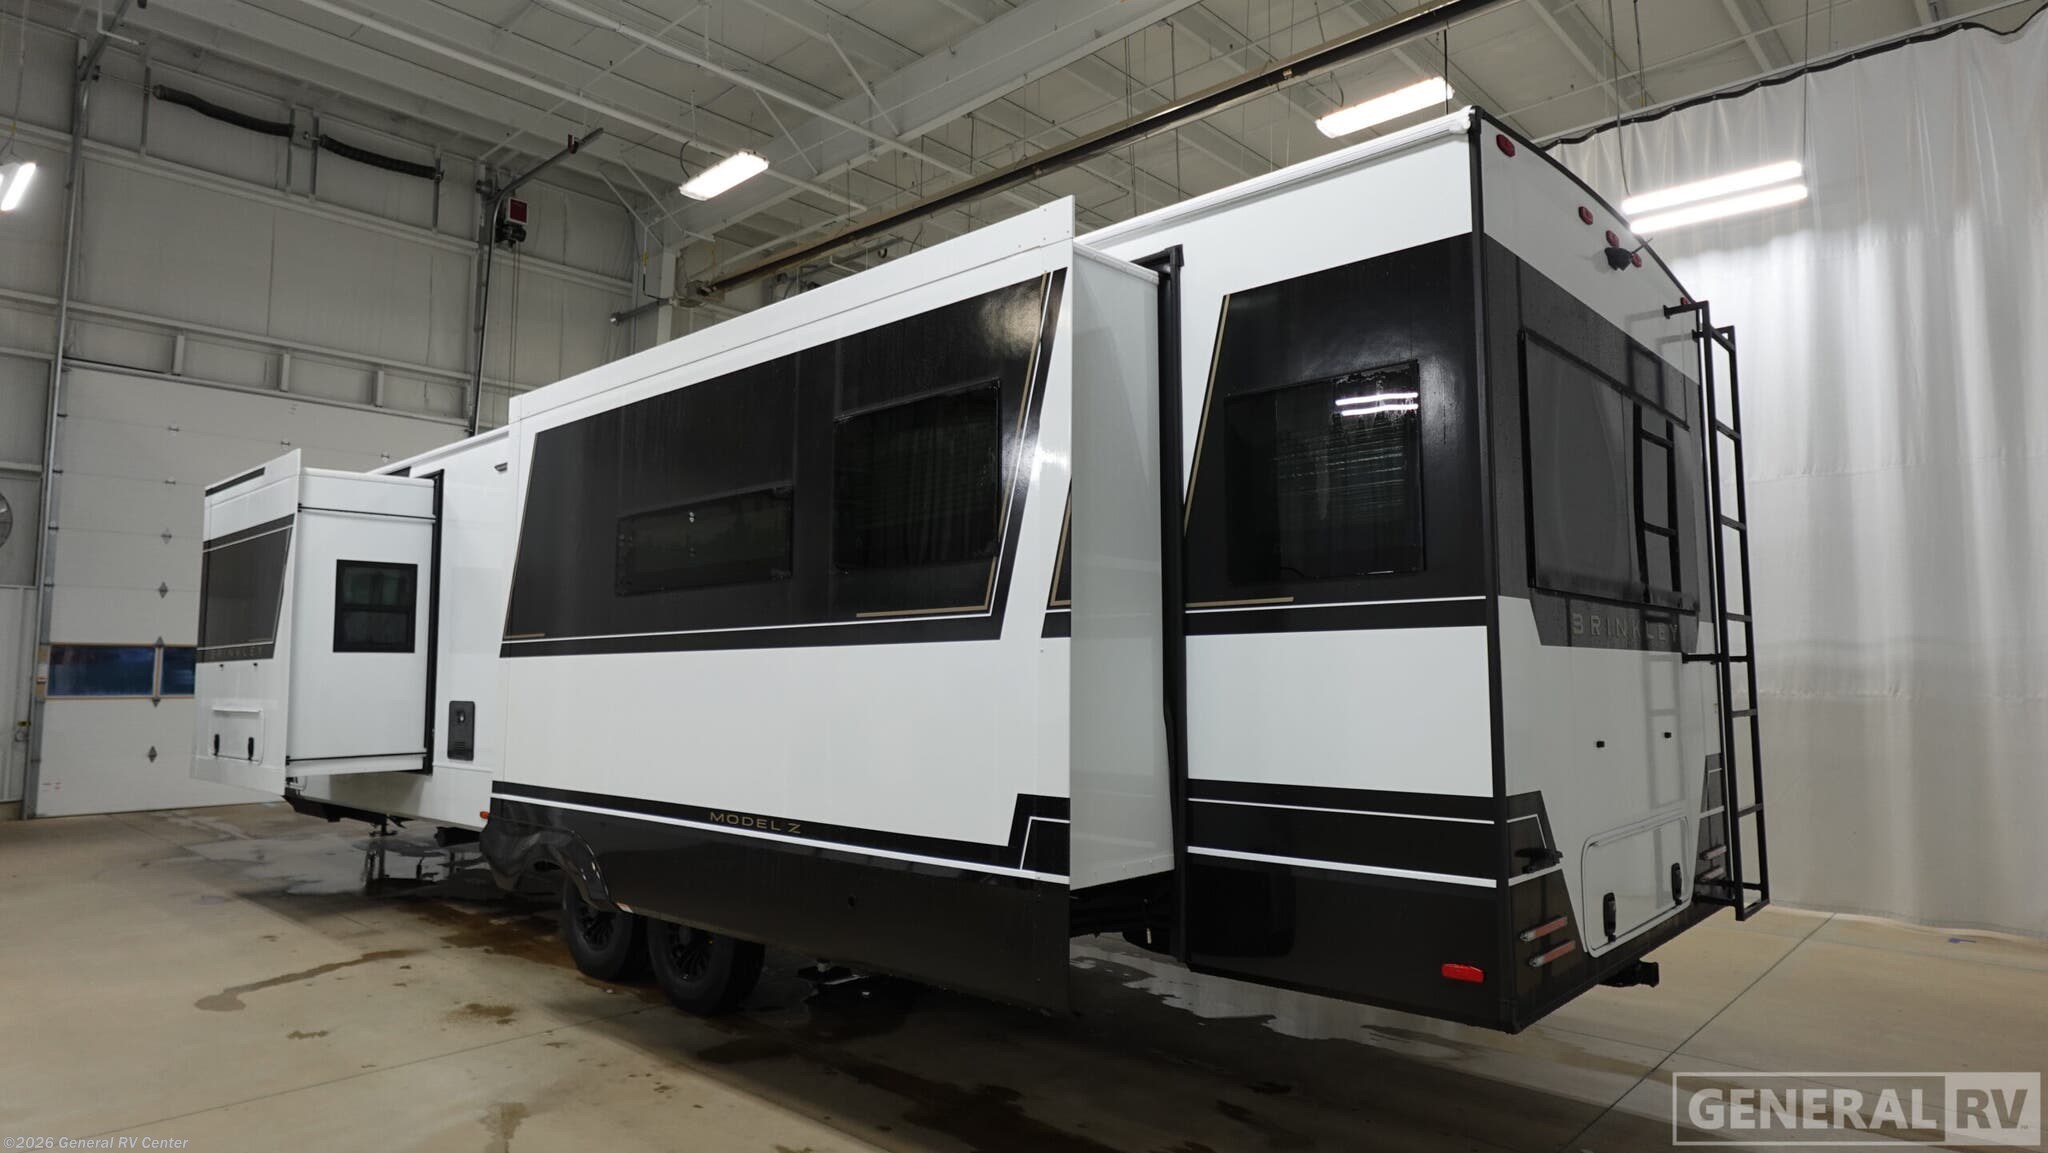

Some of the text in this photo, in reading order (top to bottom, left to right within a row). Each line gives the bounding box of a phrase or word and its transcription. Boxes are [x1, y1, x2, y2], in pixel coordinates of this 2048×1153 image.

[1571, 612, 1679, 642] BRINKLEY
[709, 811, 801, 834] MODEL Z
